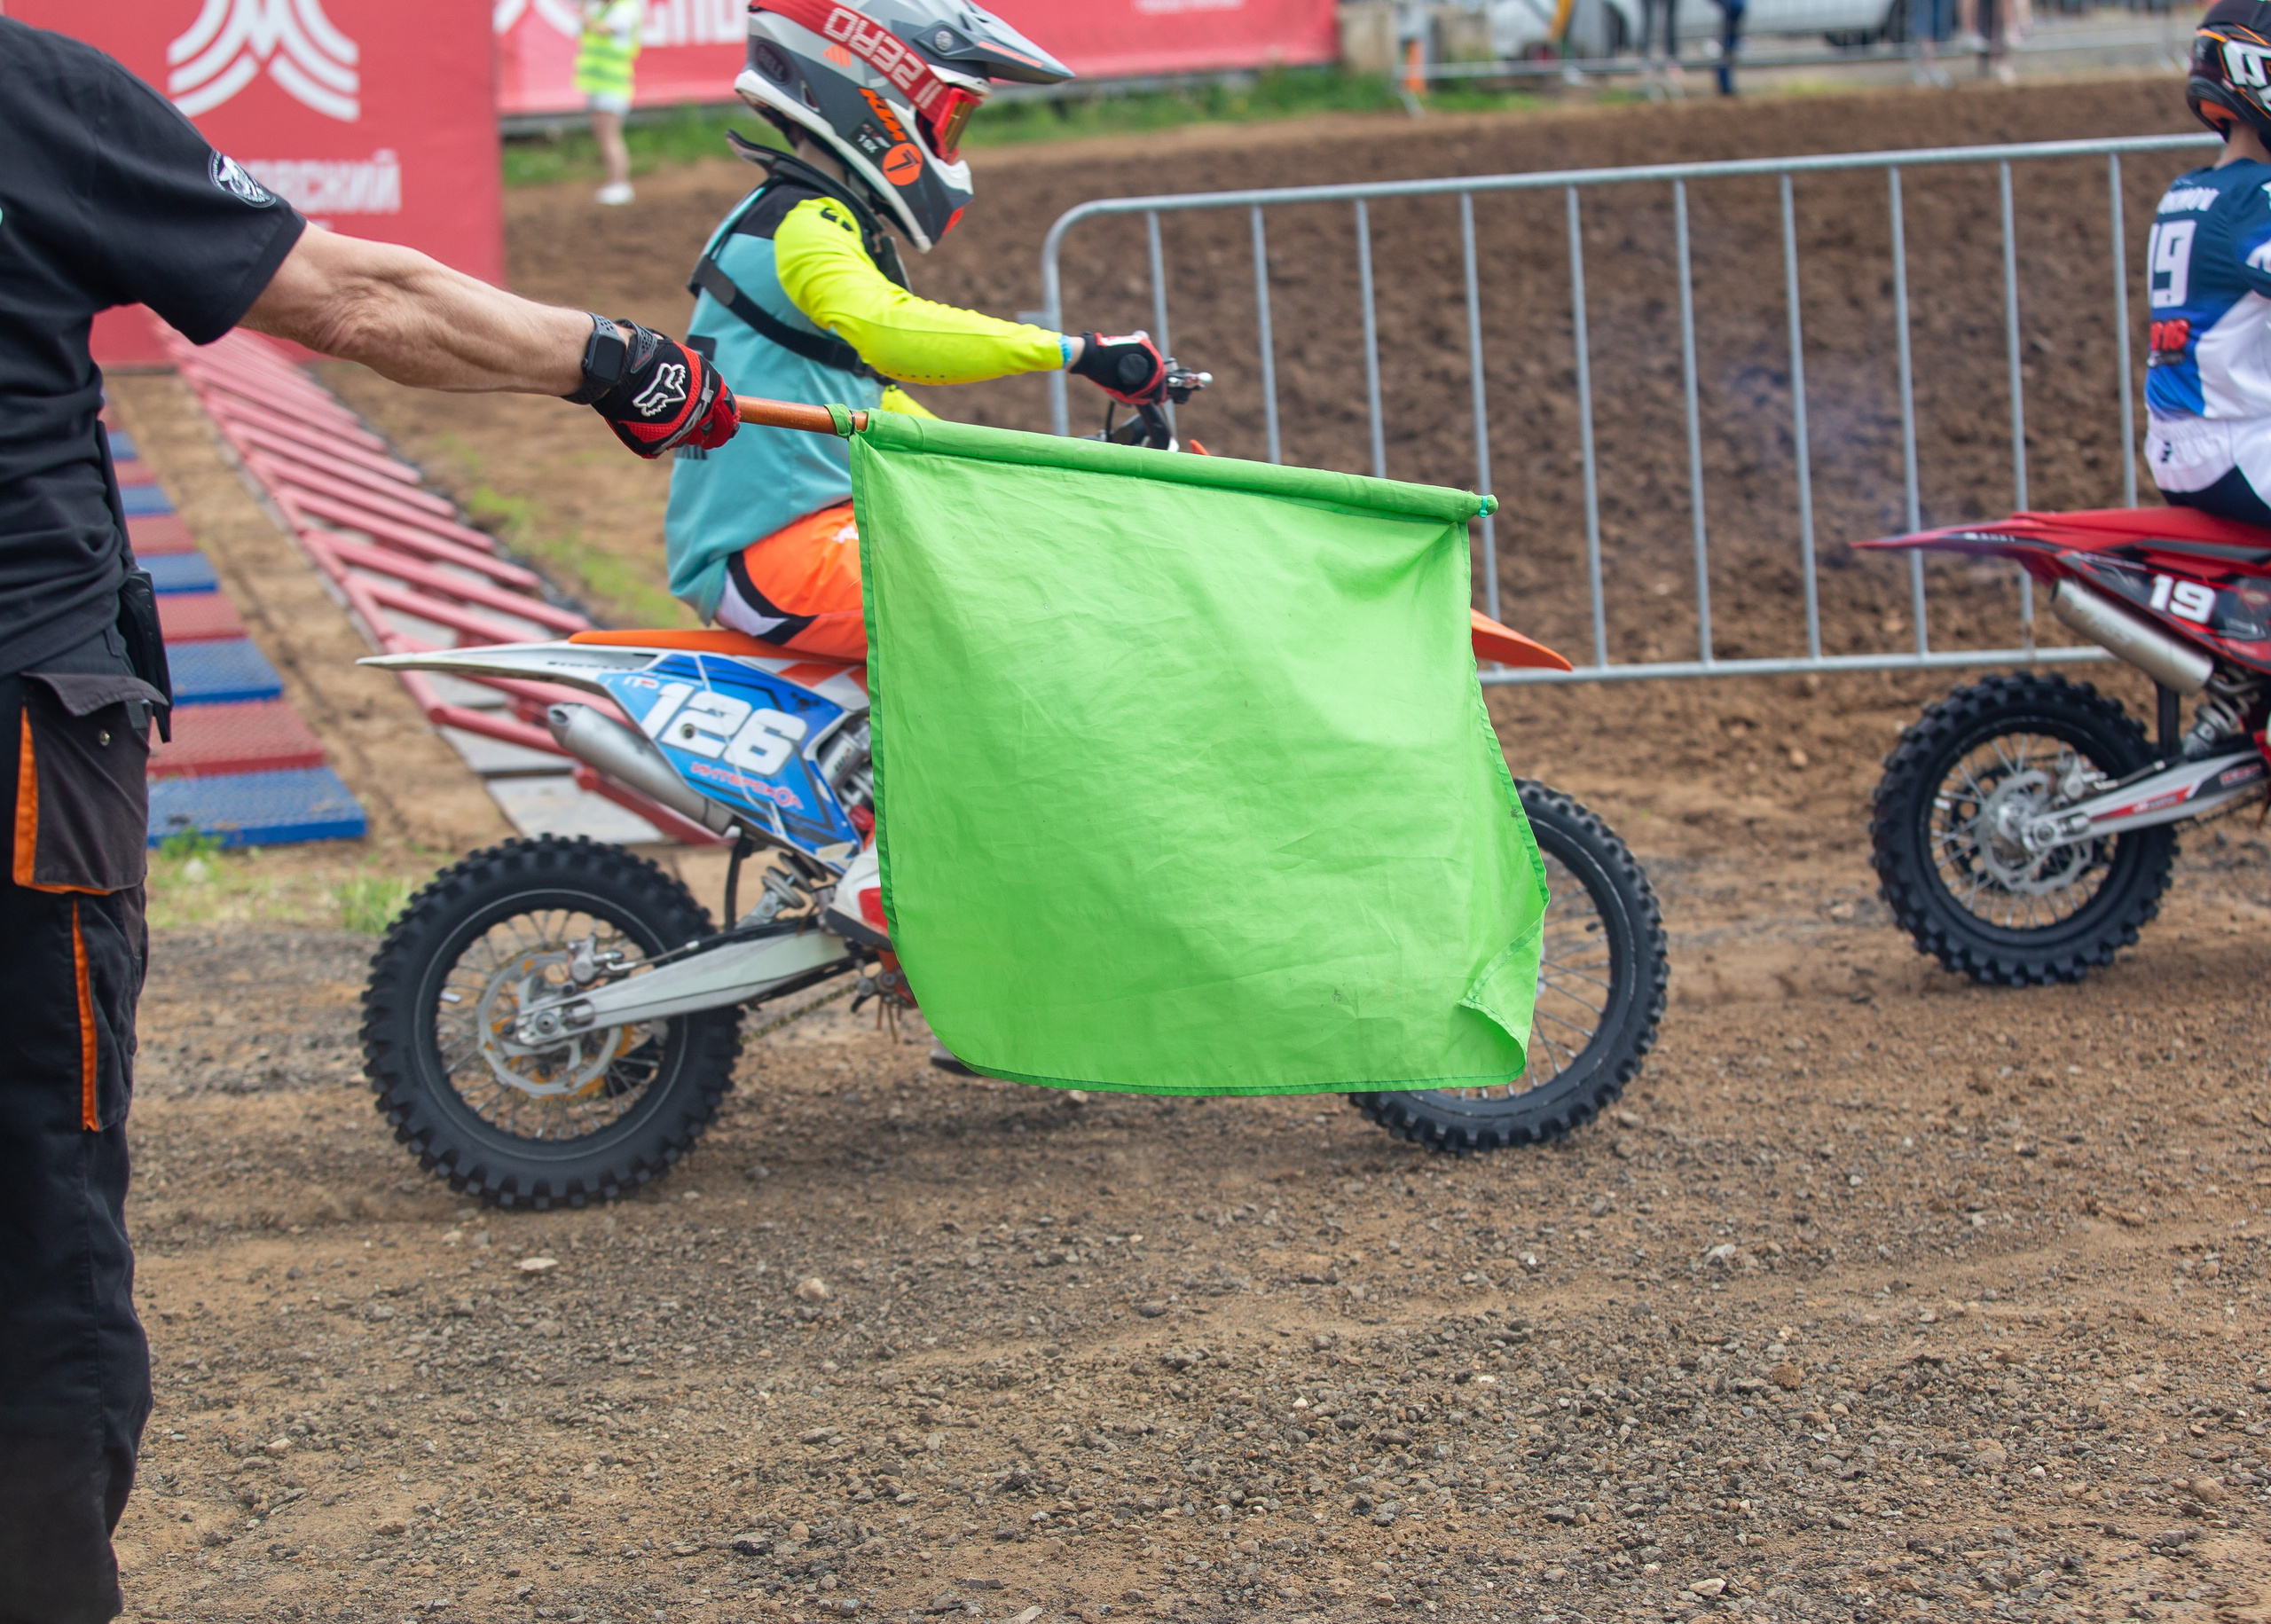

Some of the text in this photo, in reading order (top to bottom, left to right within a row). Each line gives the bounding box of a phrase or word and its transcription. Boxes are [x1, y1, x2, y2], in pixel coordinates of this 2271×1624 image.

[857, 88, 908, 141] KTM
[2149, 573, 2216, 624] 19
[640, 681, 808, 776] 126
